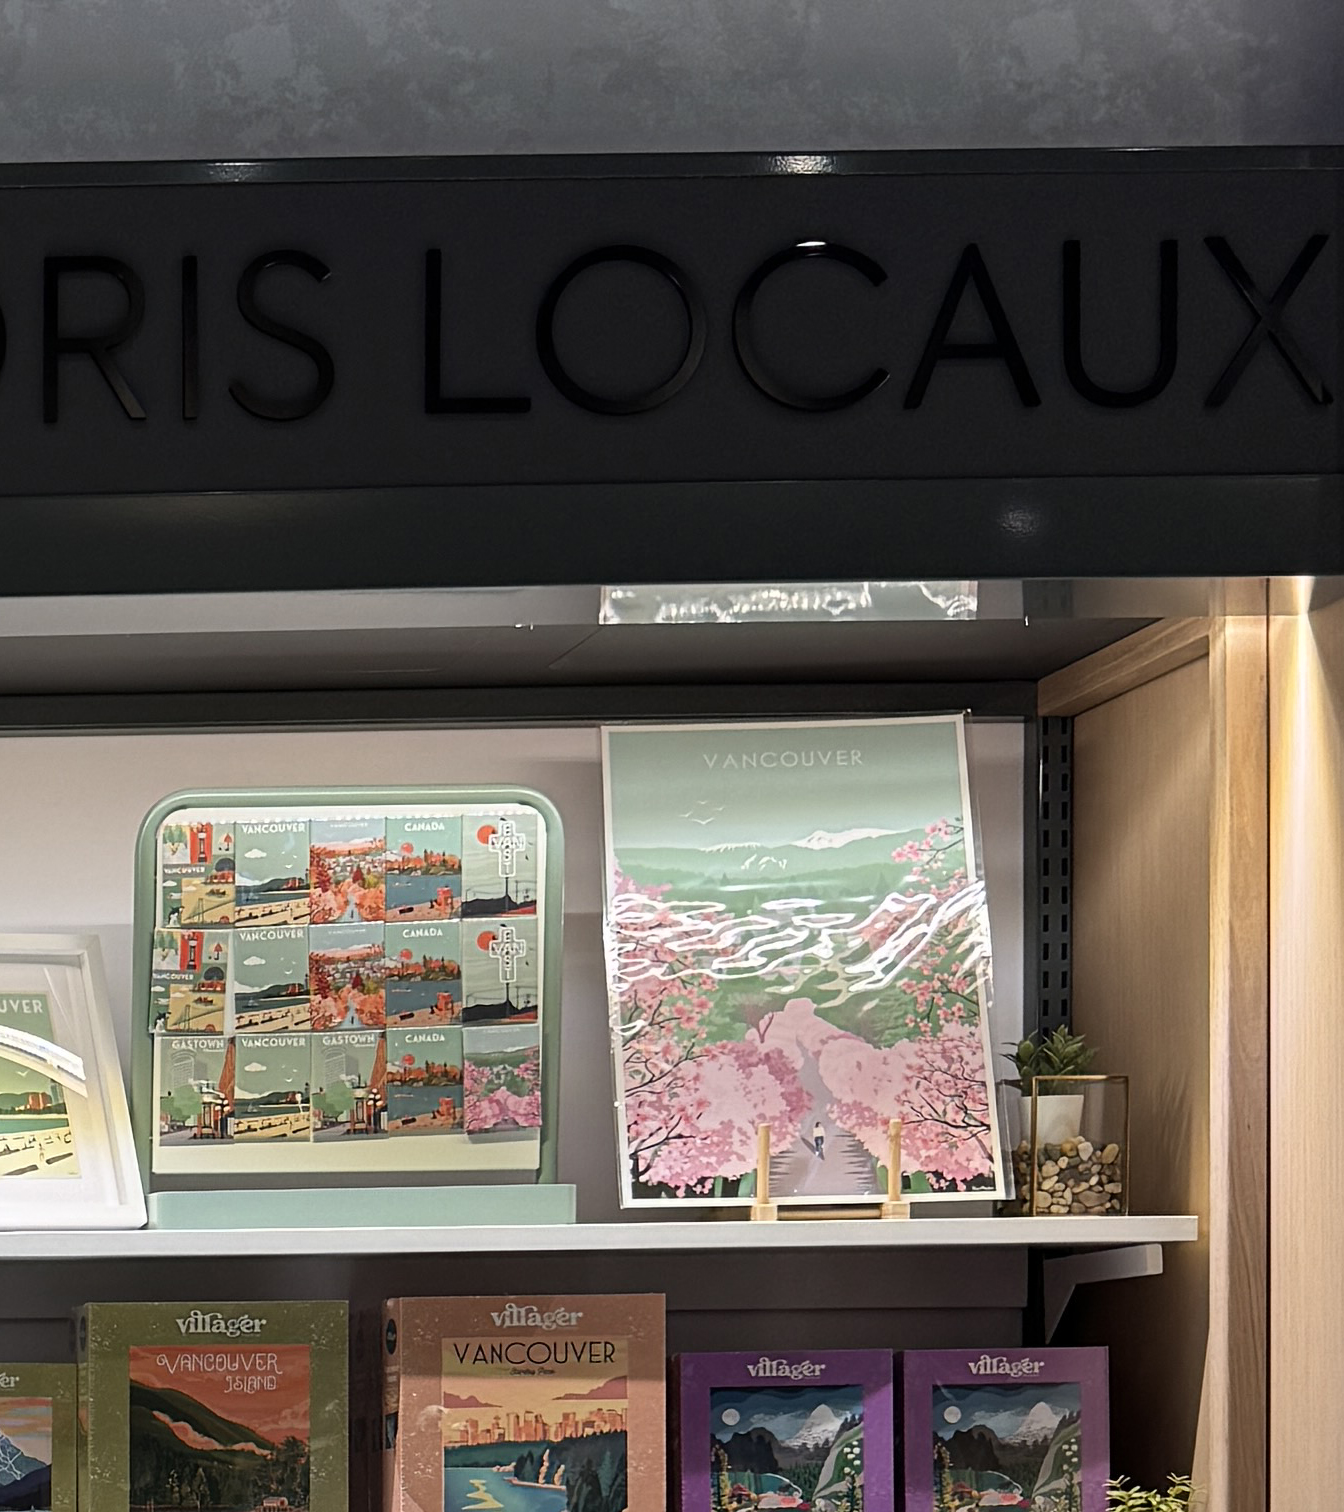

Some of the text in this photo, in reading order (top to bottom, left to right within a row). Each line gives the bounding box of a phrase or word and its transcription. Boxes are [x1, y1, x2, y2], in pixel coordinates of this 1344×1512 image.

[423, 232, 1337, 416] LOCAUX
[703, 749, 863, 769] VANCOUVER
[242, 822, 306, 835] VANCOUVER
[404, 822, 445, 833] CANADA
[240, 930, 305, 942] VANCOUVER
[402, 928, 443, 939] CANADA
[171, 1039, 225, 1050] GASTOWN
[240, 1037, 306, 1048] VANCOUVER
[321, 1034, 376, 1046] GASTOWN
[404, 1033, 446, 1044] CANADA
[175, 1309, 267, 1338] villager
[491, 1303, 584, 1331] villager
[453, 1340, 615, 1365] VANCOUVER
[157, 1352, 283, 1375] VANCOUVER
[747, 1357, 826, 1381] villager
[968, 1355, 1045, 1378] villager
[224, 1375, 277, 1394] ISLAND
